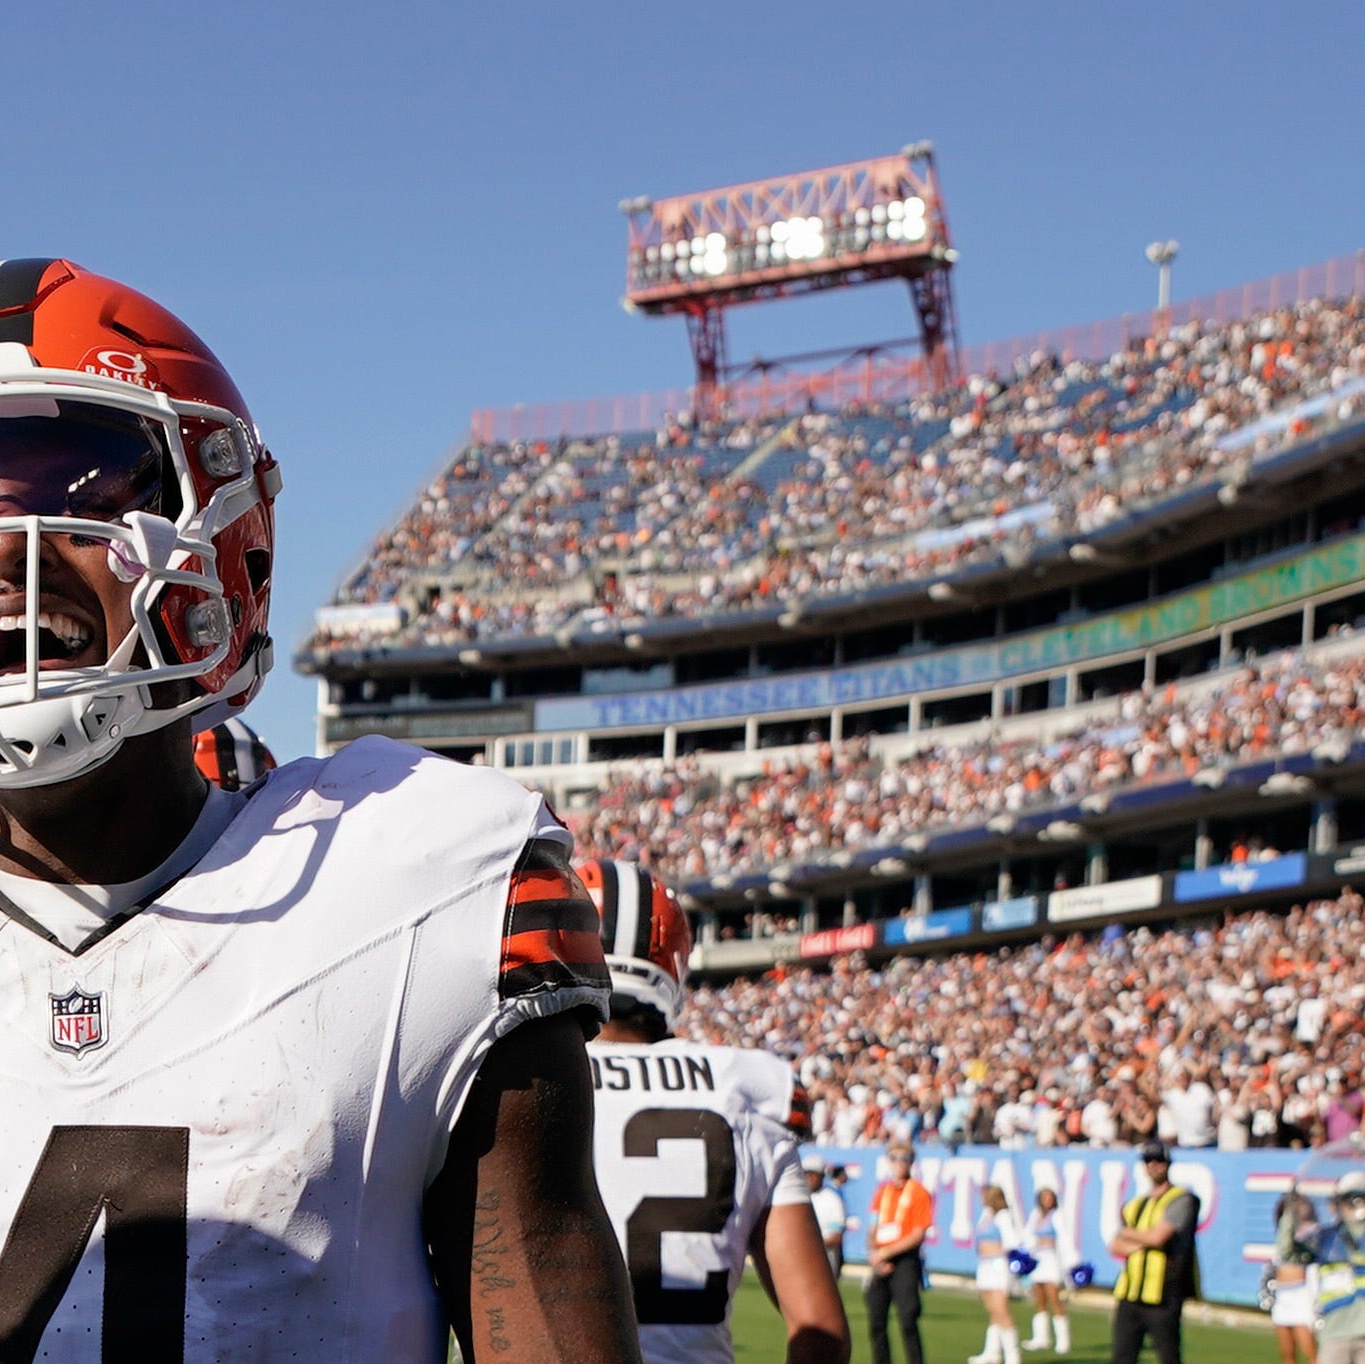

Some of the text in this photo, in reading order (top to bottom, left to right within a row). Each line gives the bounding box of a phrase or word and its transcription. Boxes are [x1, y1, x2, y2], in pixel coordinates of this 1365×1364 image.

[84, 364, 158, 391] OAKLEY
[999, 538, 1360, 673] CLEVELAND BROWNS
[594, 675, 820, 727] TENNESSEE
[830, 654, 961, 701] TITANS
[57, 1016, 99, 1043] NFL
[623, 1108, 736, 1325] 2
